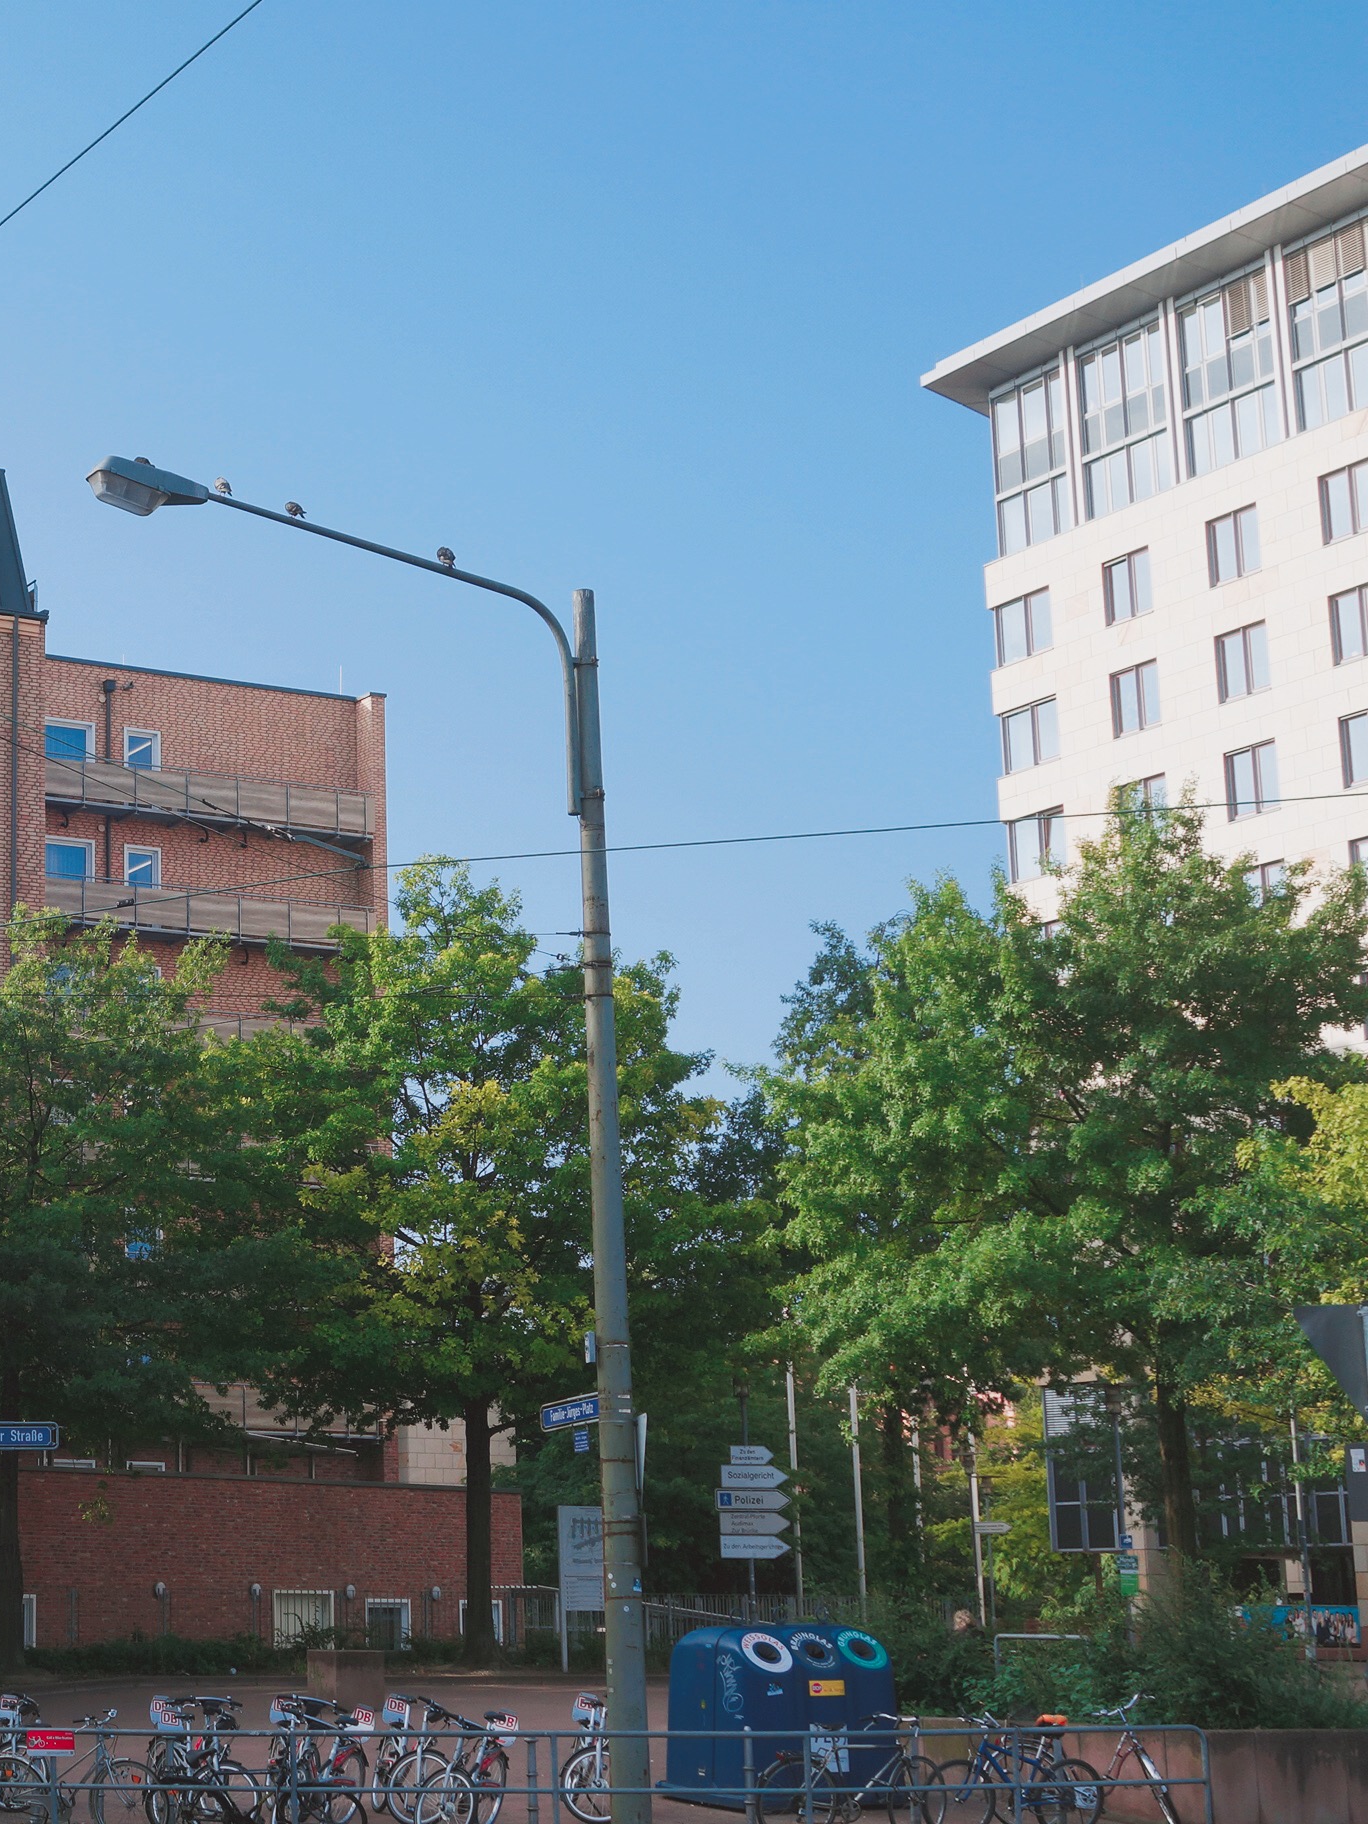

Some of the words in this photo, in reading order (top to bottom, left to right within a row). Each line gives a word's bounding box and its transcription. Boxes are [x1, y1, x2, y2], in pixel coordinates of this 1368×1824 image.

[10, 1429, 44, 1443] Straße
[727, 1471, 775, 1481] Sozialgericht
[734, 1495, 764, 1504] Polizei
[390, 1699, 405, 1711] DB
[355, 1710, 372, 1722] DB
